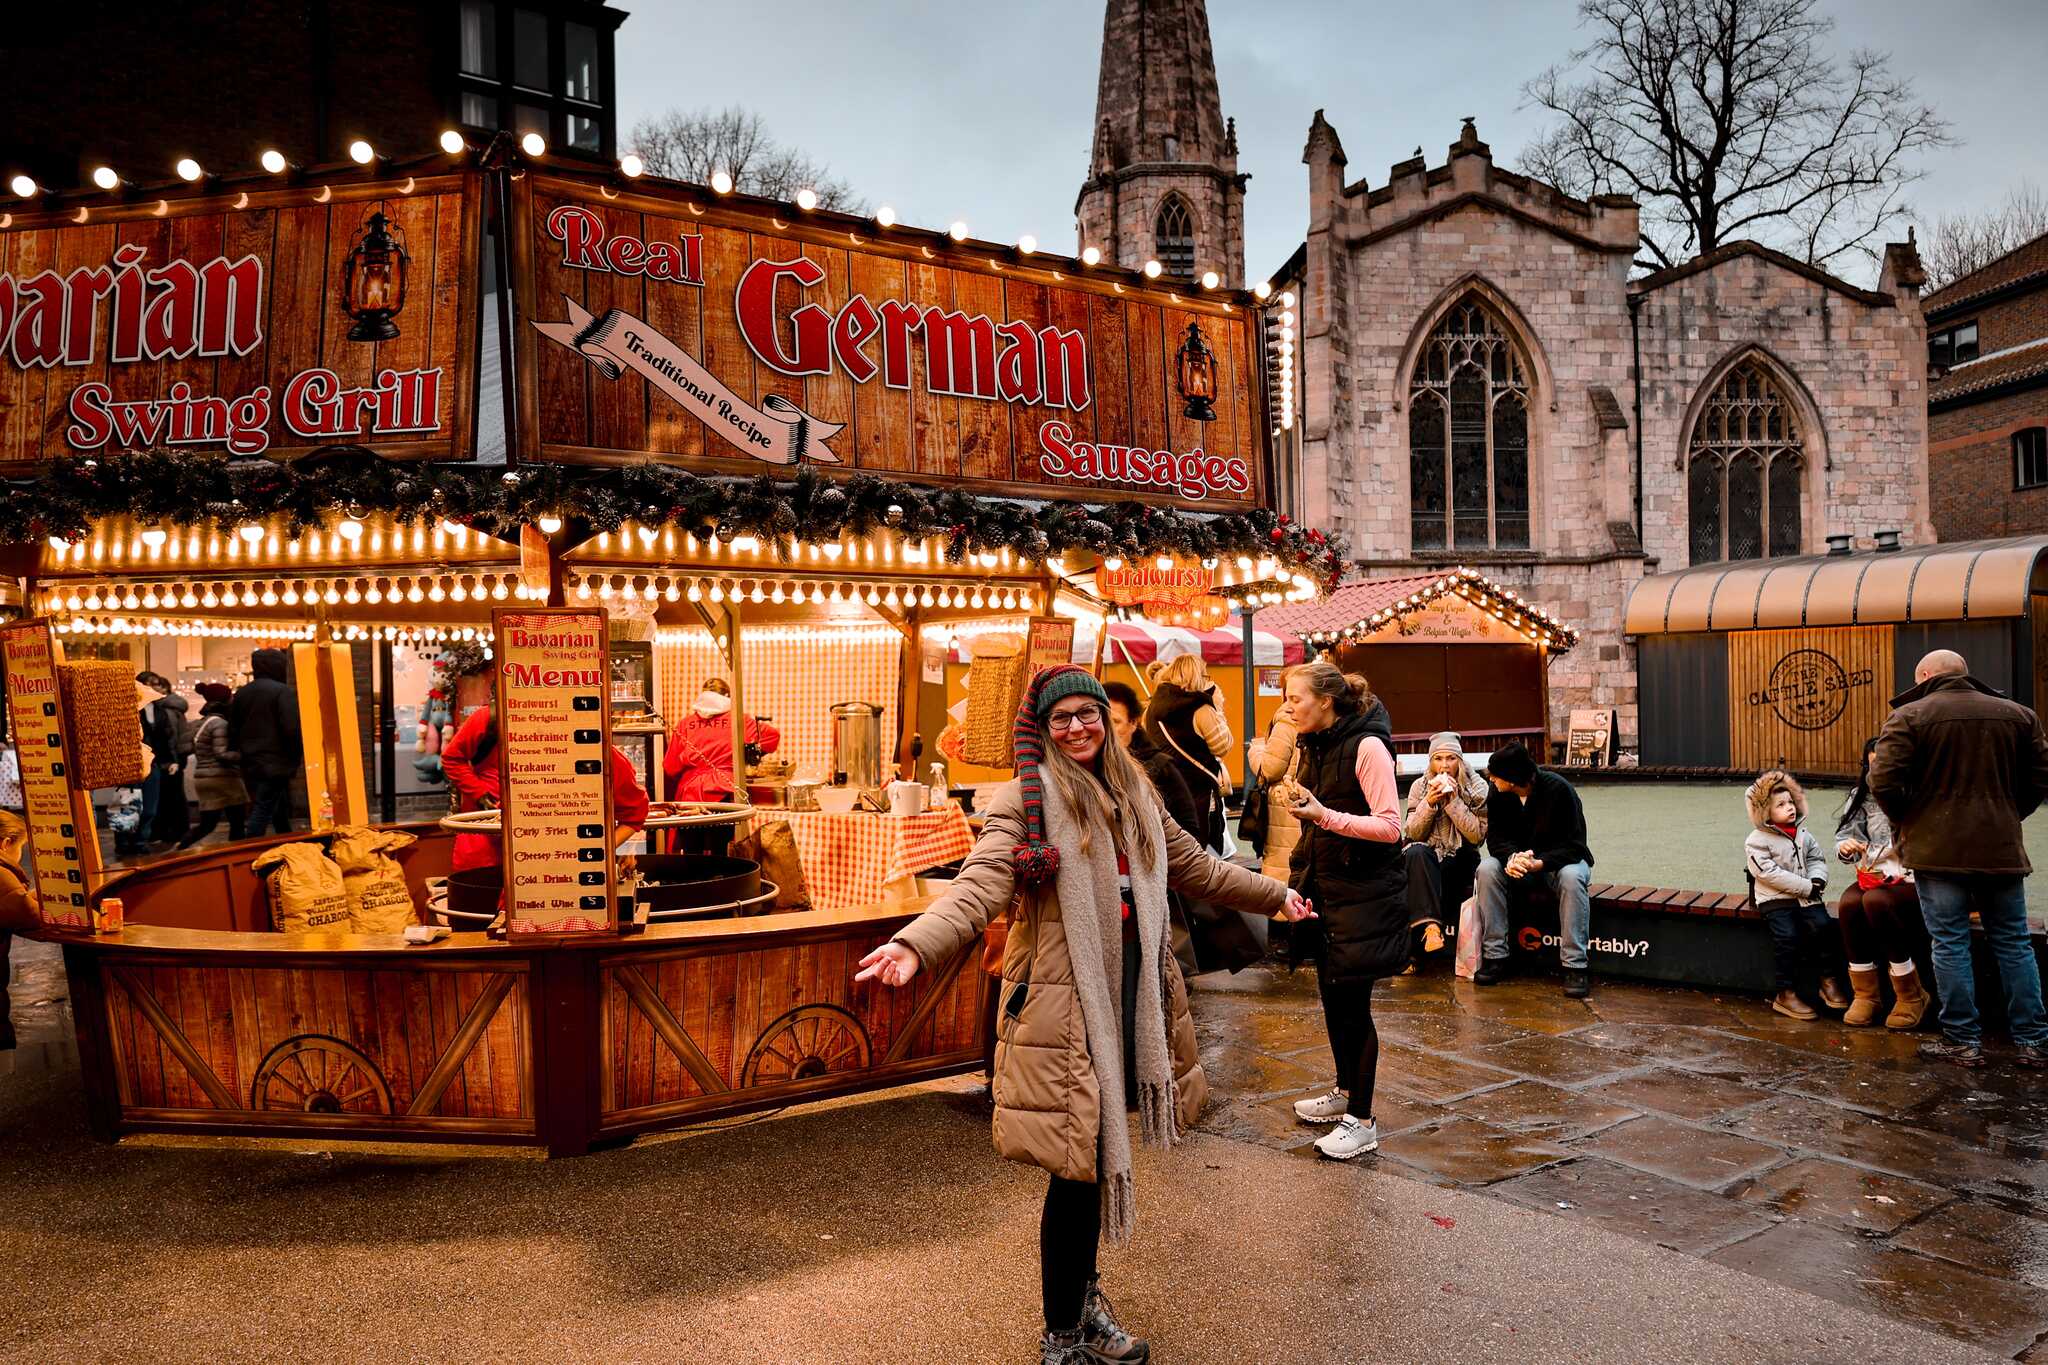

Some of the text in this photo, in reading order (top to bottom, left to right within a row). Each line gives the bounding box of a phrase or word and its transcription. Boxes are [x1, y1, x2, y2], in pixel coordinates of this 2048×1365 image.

[548, 206, 705, 286] Real
[736, 257, 1091, 411] German
[624, 330, 772, 448] Traditional Recipe
[67, 367, 442, 455] Swing Grill
[1040, 420, 1250, 500] Sausages
[511, 629, 594, 648] Bavarian
[543, 650, 577, 660] Swing
[503, 662, 602, 689] Menu
[1794, 668, 1817, 681] THE
[8, 672, 55, 695] Menu
[1749, 669, 1874, 705] CATTLE SHED
[508, 699, 558, 709] Bratwurst
[529, 714, 568, 723] Original
[689, 719, 728, 729] STAFF
[510, 747, 541, 755] Cheese
[510, 763, 556, 772] Krakauer
[513, 827, 540, 839] Curly
[545, 827, 568, 836] Fries
[514, 851, 593, 862] Cheesey Fries 6
[515, 875, 595, 886] Cold Drinks 2
[551, 900, 574, 908] Wine
